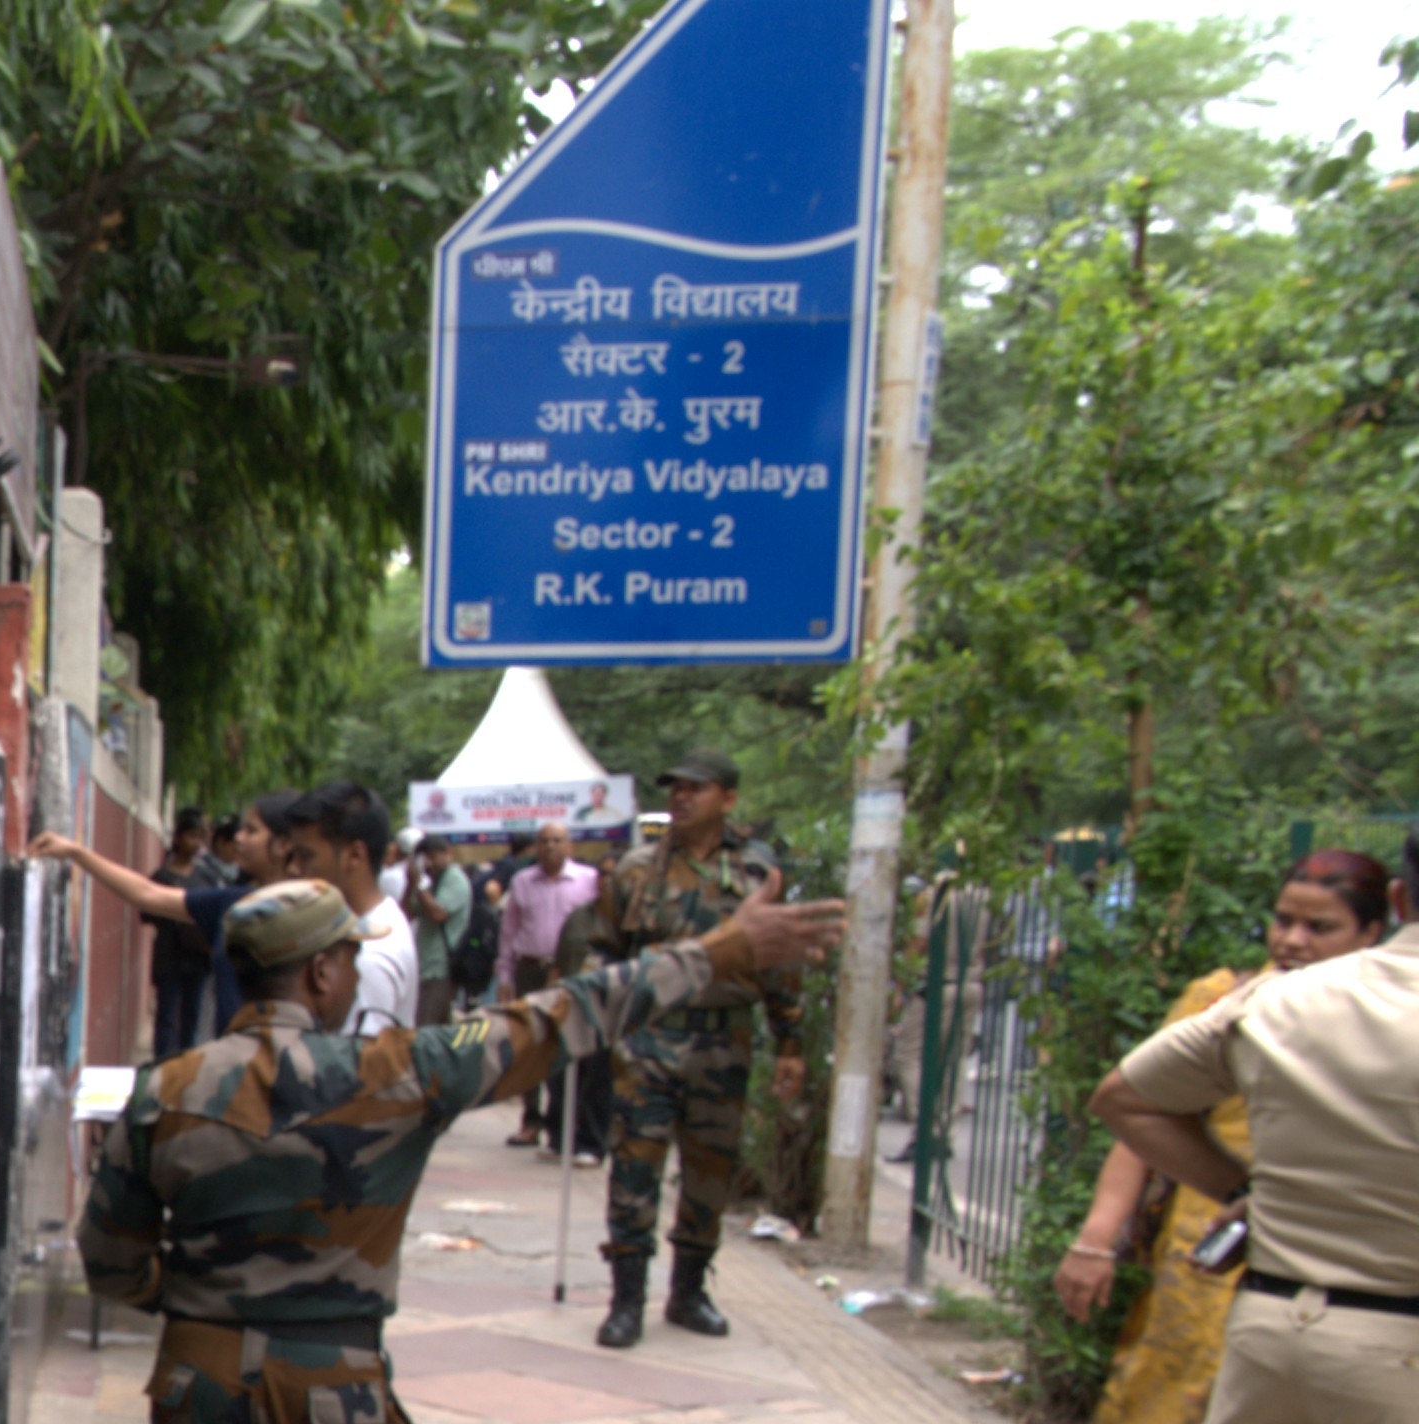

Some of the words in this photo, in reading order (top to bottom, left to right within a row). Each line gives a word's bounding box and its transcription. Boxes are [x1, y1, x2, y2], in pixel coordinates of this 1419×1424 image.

[510, 275, 632, 323] केन्द्रीय
[651, 273, 801, 320] विद्यालय
[560, 332, 670, 377] सैक्टर
[721, 340, 746, 374] 2
[536, 387, 666, 433] आर.के.
[683, 397, 763, 445] पुरम
[464, 462, 634, 501] Kendriya
[644, 459, 828, 498] Vidyalaya
[554, 517, 679, 550] Sector
[711, 515, 735, 548] 2
[534, 573, 612, 605] R.K.
[624, 572, 747, 603] Puram
